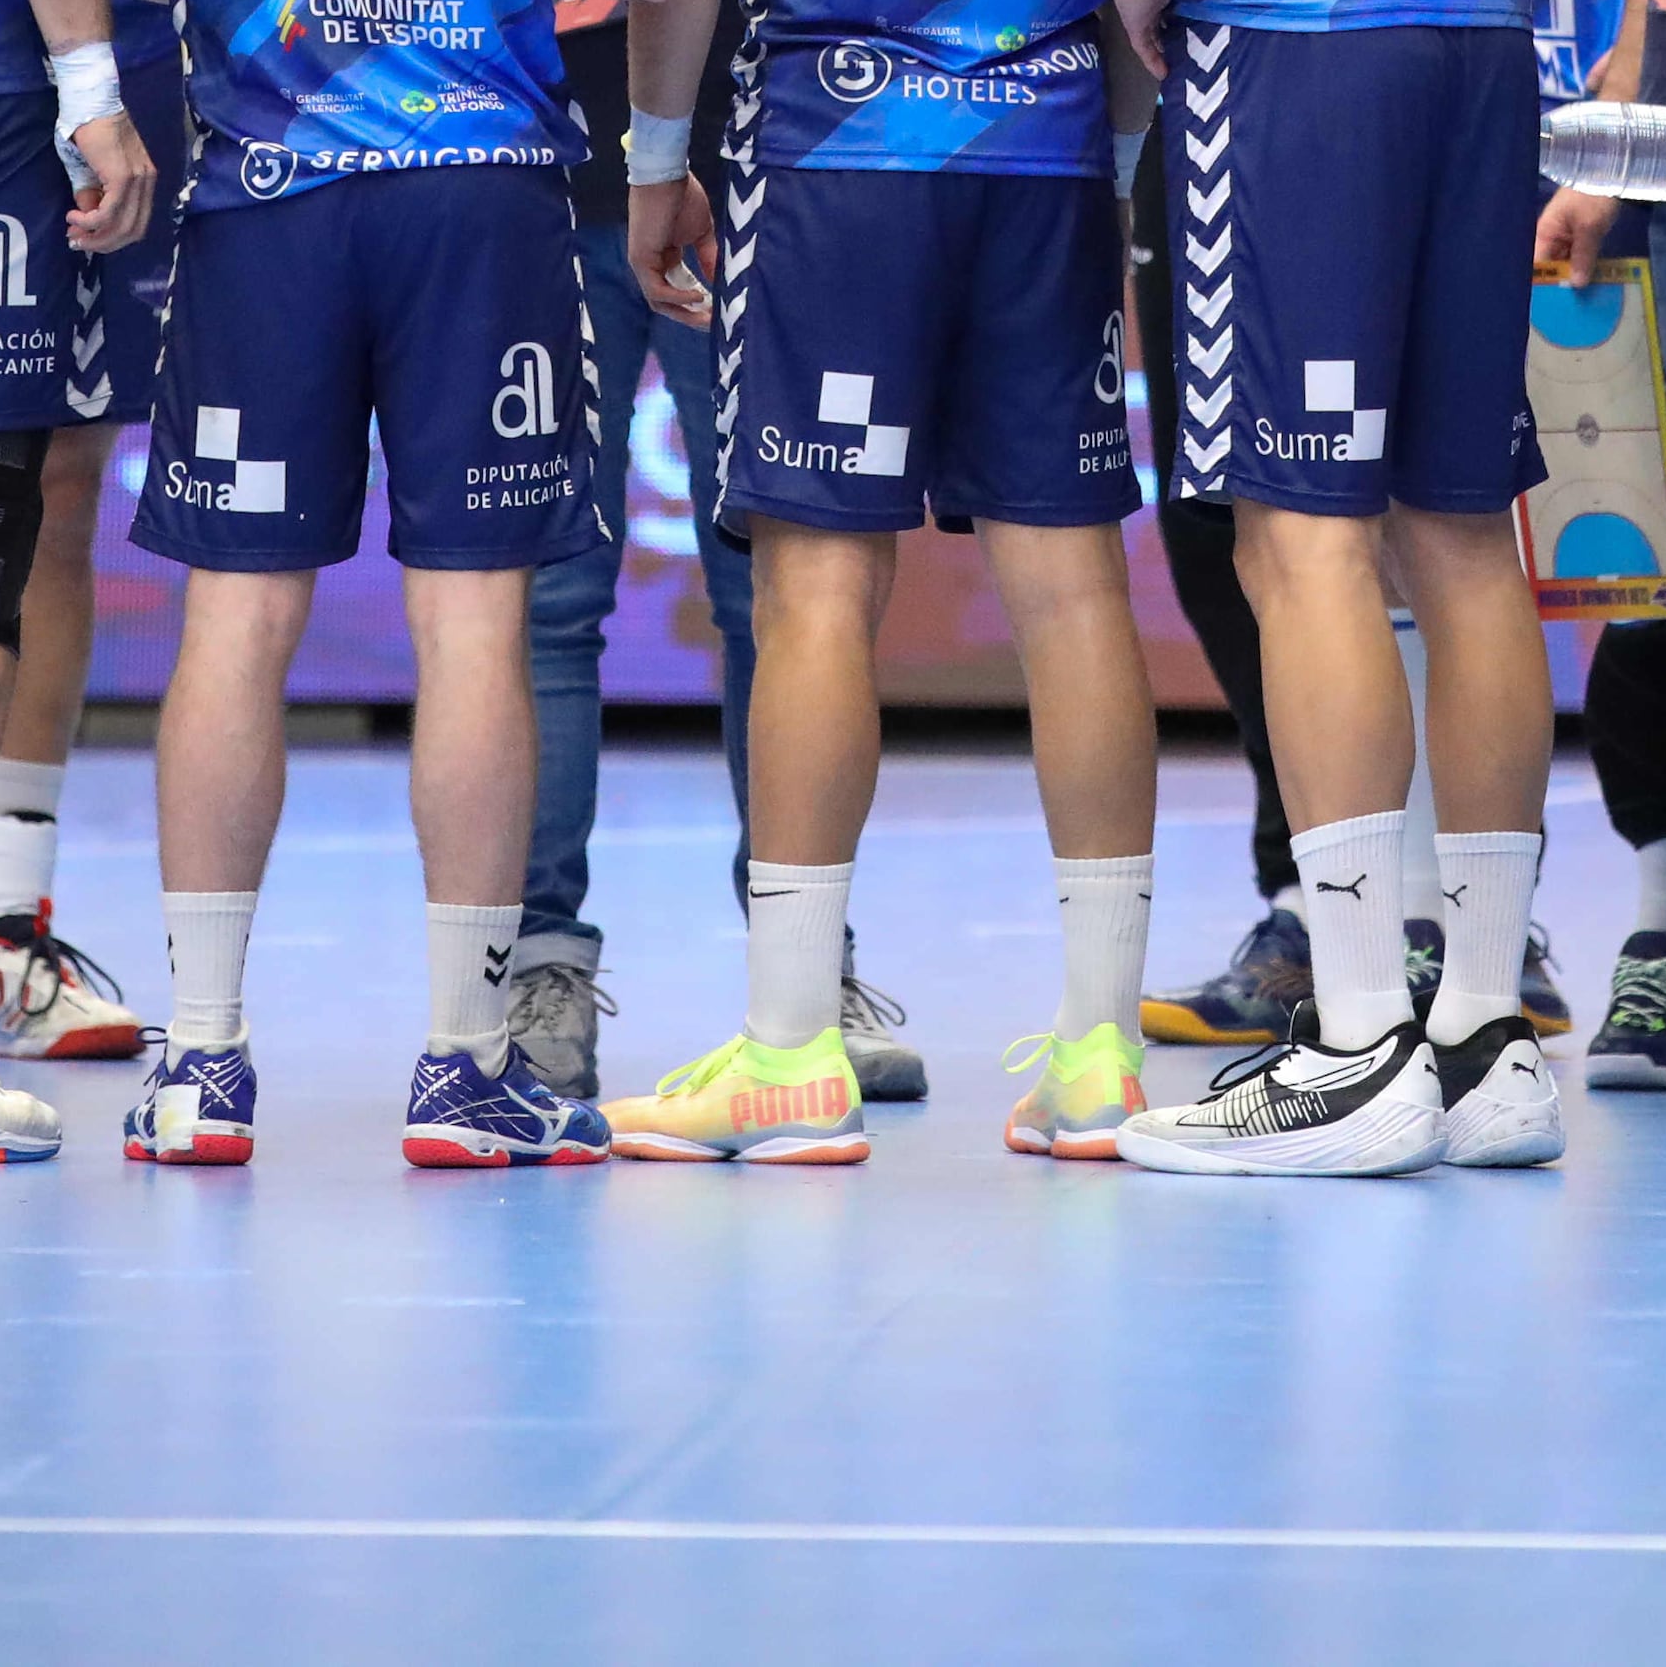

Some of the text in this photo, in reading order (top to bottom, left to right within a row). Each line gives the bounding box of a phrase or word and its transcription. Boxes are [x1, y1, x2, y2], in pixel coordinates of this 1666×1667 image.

[323, 20, 485, 50] DE L'ESPORT
[296, 92, 366, 104] GENERALITAT
[903, 75, 1037, 105] HOTELES
[757, 425, 864, 474] Suma
[1079, 427, 1127, 450] DIPUTA
[1255, 417, 1352, 461] Suma
[1079, 456, 1099, 474] DE
[466, 492, 492, 511] DE
[729, 1077, 849, 1133] PUMA
